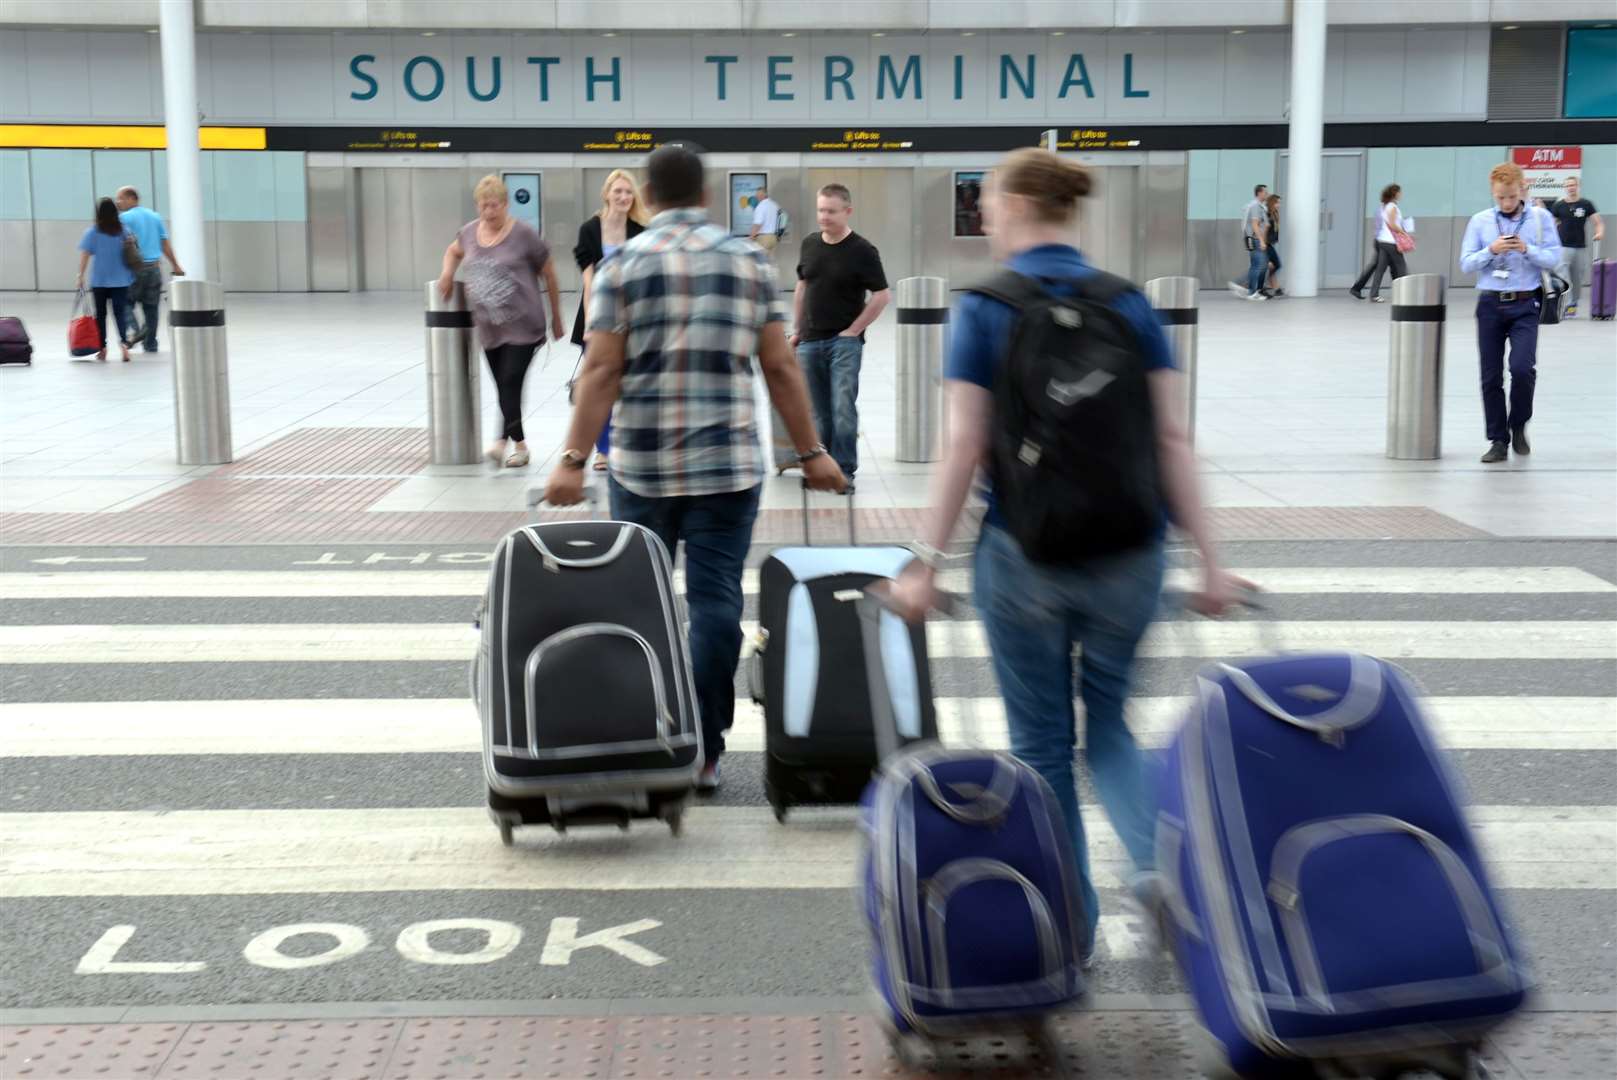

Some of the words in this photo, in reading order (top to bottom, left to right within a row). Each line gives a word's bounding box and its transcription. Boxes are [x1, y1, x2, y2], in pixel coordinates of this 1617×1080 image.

[350, 54, 621, 102] SOUTH
[704, 53, 1150, 101] TERMINAL
[1531, 149, 1564, 162] ATM
[292, 551, 496, 565] GHT
[74, 916, 669, 974] LOOK
